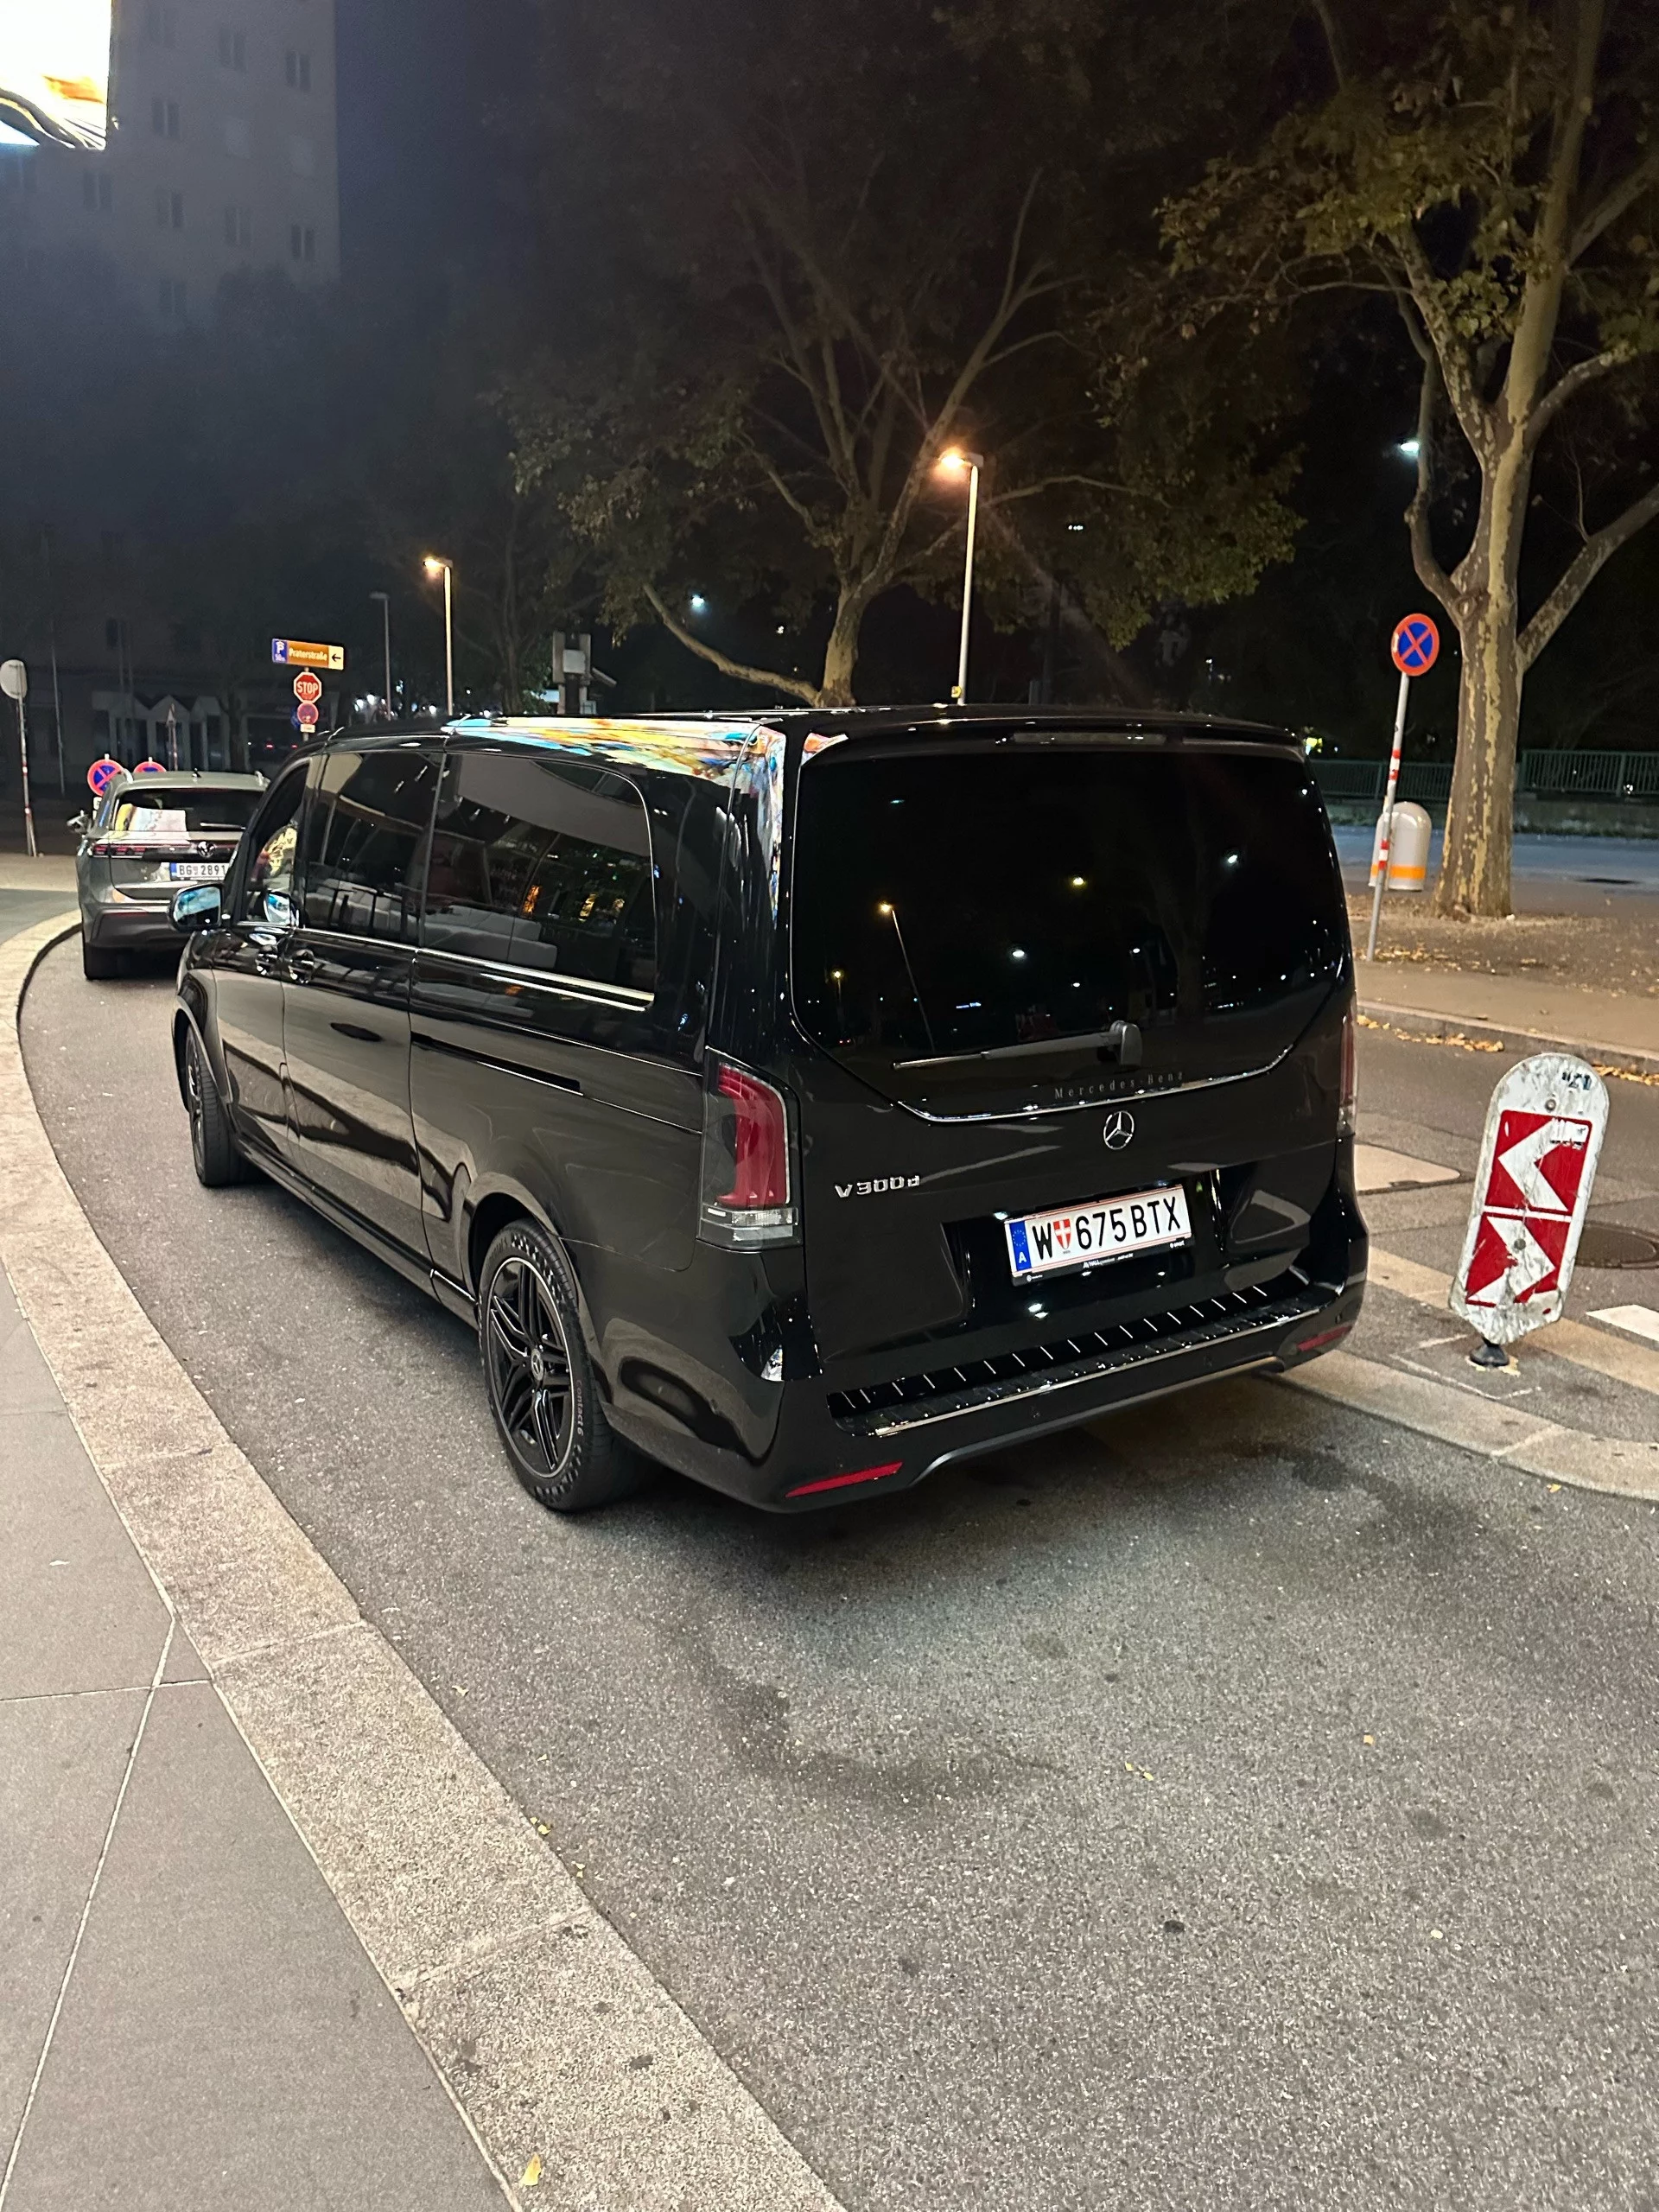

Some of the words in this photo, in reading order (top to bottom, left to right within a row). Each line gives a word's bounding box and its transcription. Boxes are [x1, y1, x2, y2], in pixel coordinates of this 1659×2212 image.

[296, 681, 319, 694] STOP
[179, 865, 192, 875] BG
[1032, 1222, 1053, 1261] W
[1018, 1251, 1027, 1264] A
